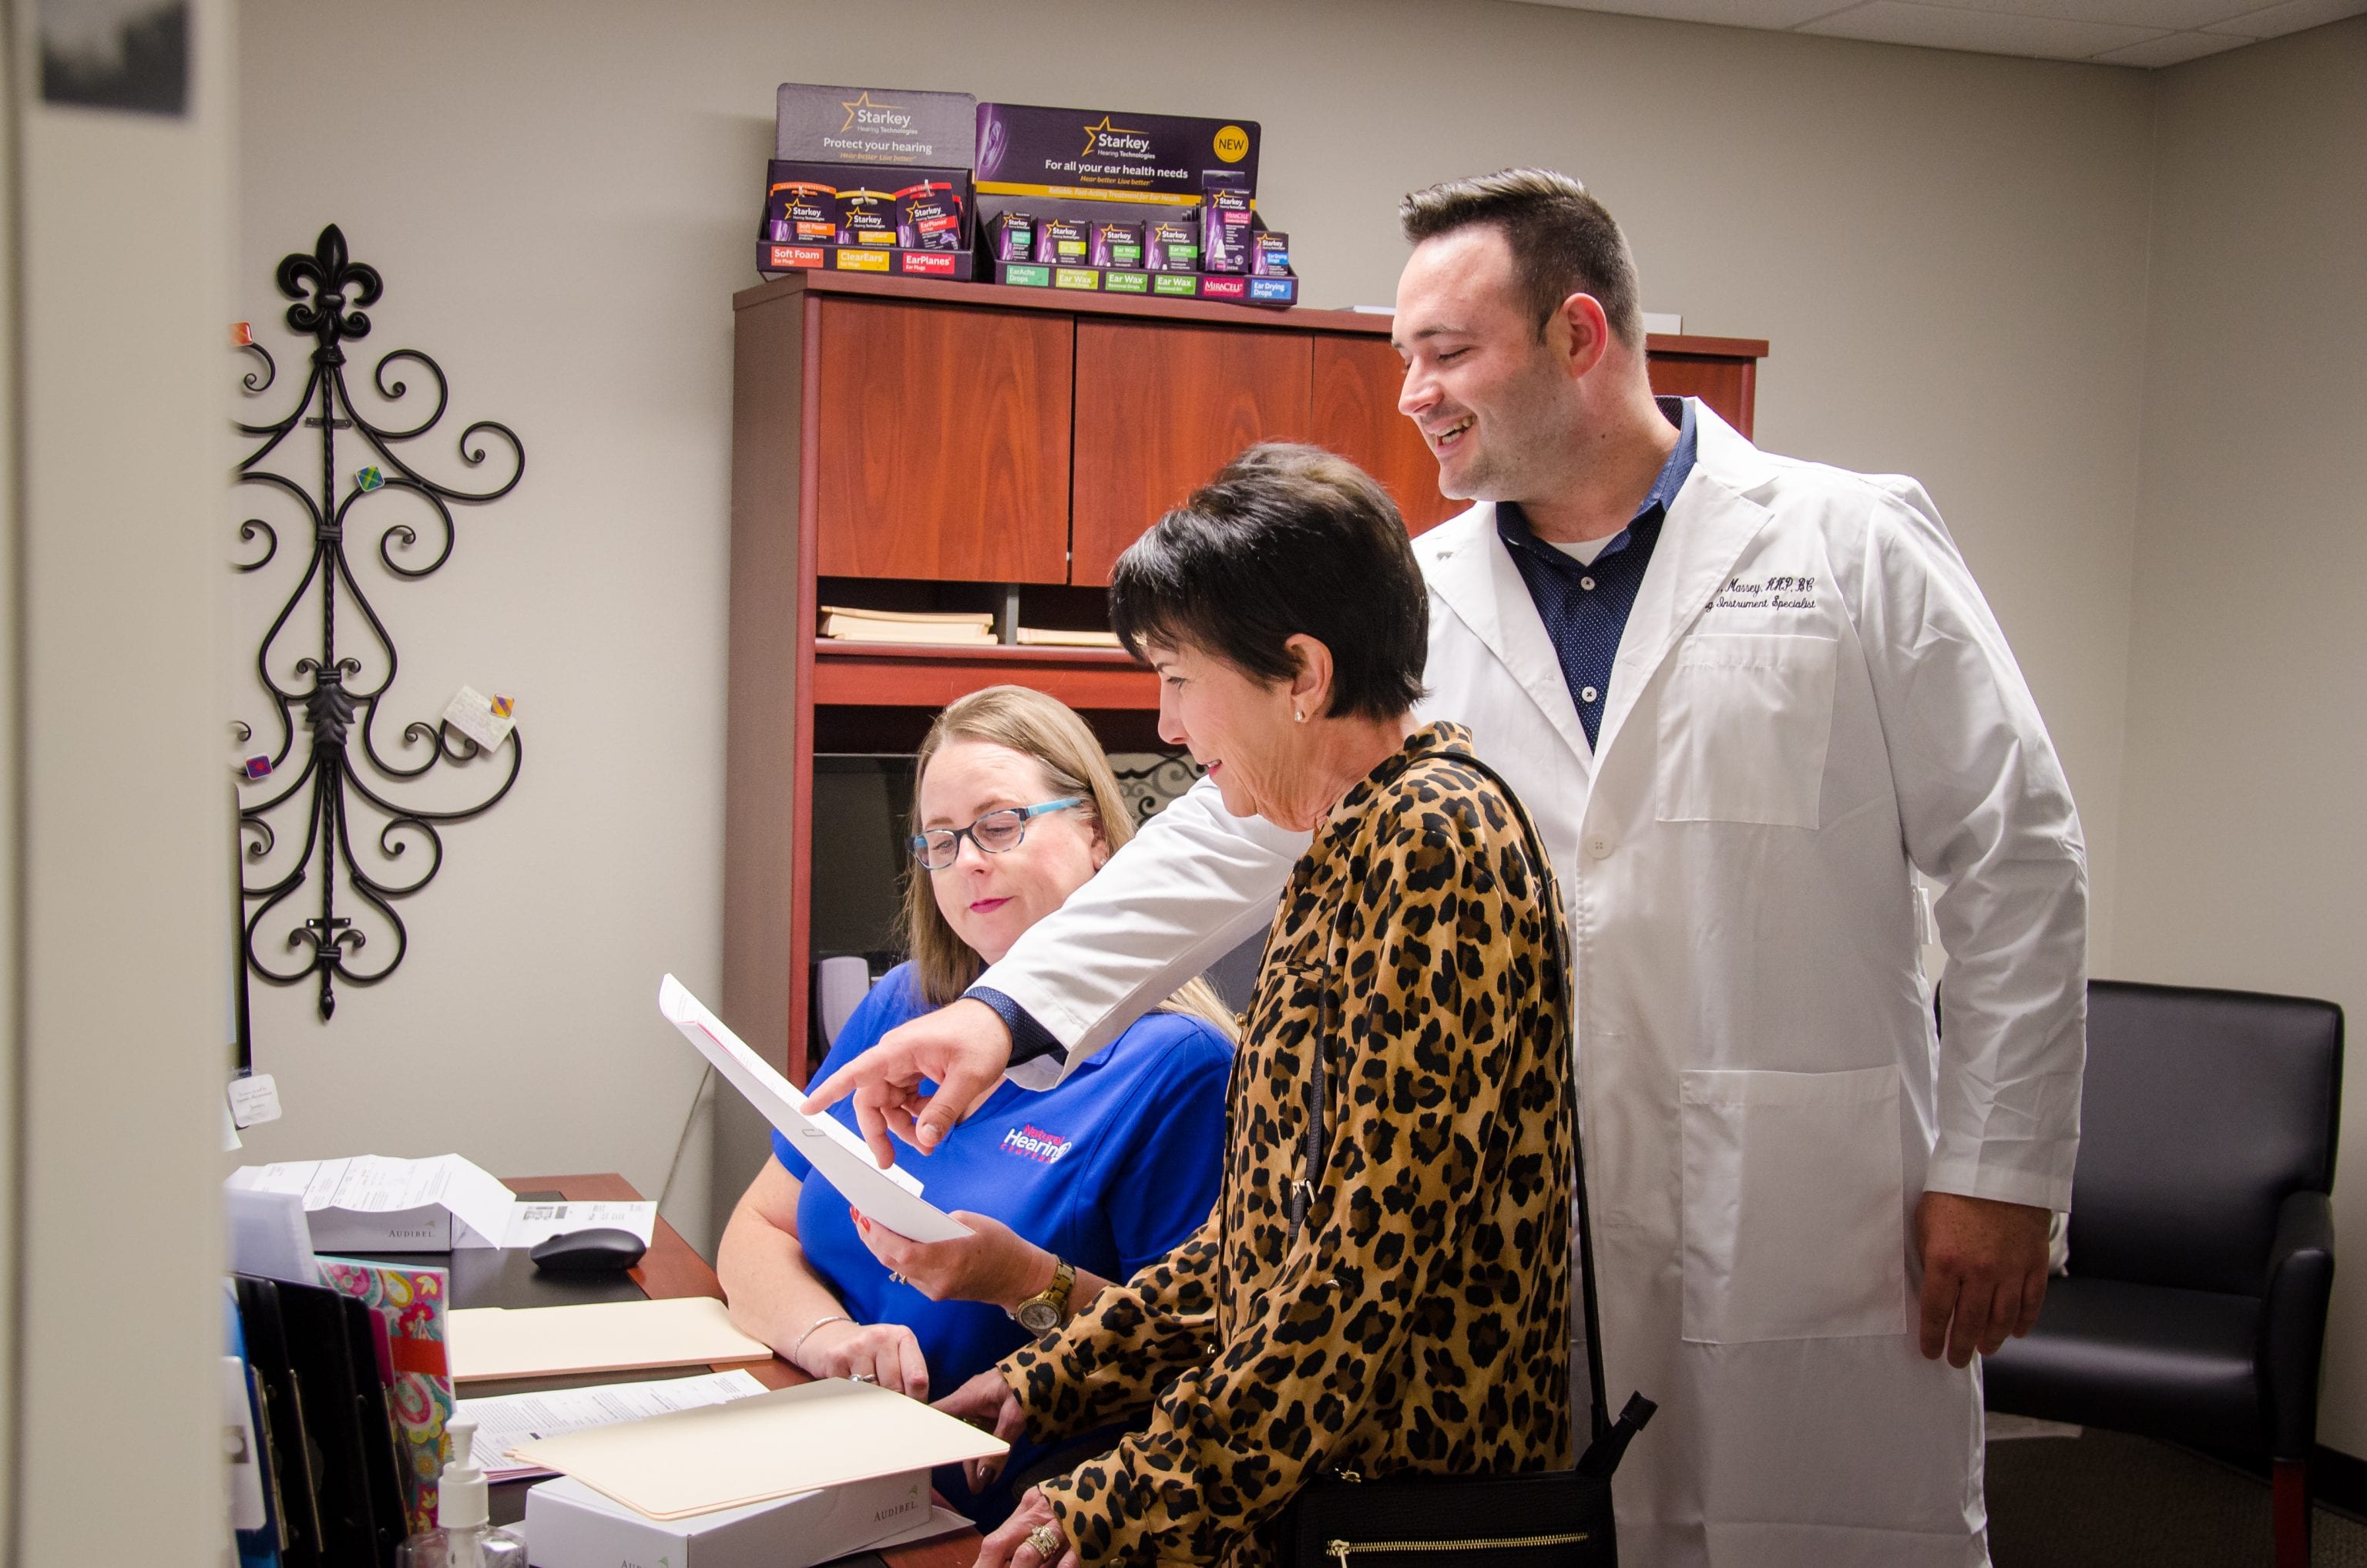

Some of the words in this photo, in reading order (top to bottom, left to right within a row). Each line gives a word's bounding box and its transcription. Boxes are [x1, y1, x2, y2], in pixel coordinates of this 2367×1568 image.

[858, 109, 911, 128] Starkey
[880, 126, 918, 136] Technologies
[824, 137, 862, 149] Protect
[865, 142, 890, 152] your
[892, 141, 932, 155] hearing
[1098, 133, 1150, 153] Starkey
[1219, 138, 1244, 150] NEW
[1120, 150, 1155, 160] Technologies
[1045, 159, 1062, 170] For
[1063, 160, 1076, 171] all
[1079, 164, 1102, 174] your
[1123, 165, 1155, 176] health
[1157, 168, 1188, 179] needs
[1220, 197, 1243, 206] Starkey
[793, 206, 821, 217] Starkey
[915, 206, 941, 217] Starkey
[854, 214, 881, 225] Starkey
[1053, 227, 1076, 237] Starkey
[1107, 231, 1131, 240] Starkey
[1162, 230, 1187, 240] Starkey
[774, 248, 793, 258] Soft
[794, 250, 819, 260] Foam
[840, 252, 883, 263] ClearEars
[906, 256, 949, 266] EarPlanes
[1009, 267, 1036, 276] EarAche
[1059, 274, 1072, 283] Ear
[1074, 275, 1091, 284] Wax
[1110, 274, 1122, 282] Ear
[1125, 275, 1143, 284] Wax
[1157, 277, 1170, 285] Ear
[1173, 277, 1191, 287] Wax
[1265, 283, 1285, 292] Drying
[1254, 289, 1272, 297] Drops
[1717, 596, 1768, 608] Instrument
[1771, 595, 1816, 610] Specialist
